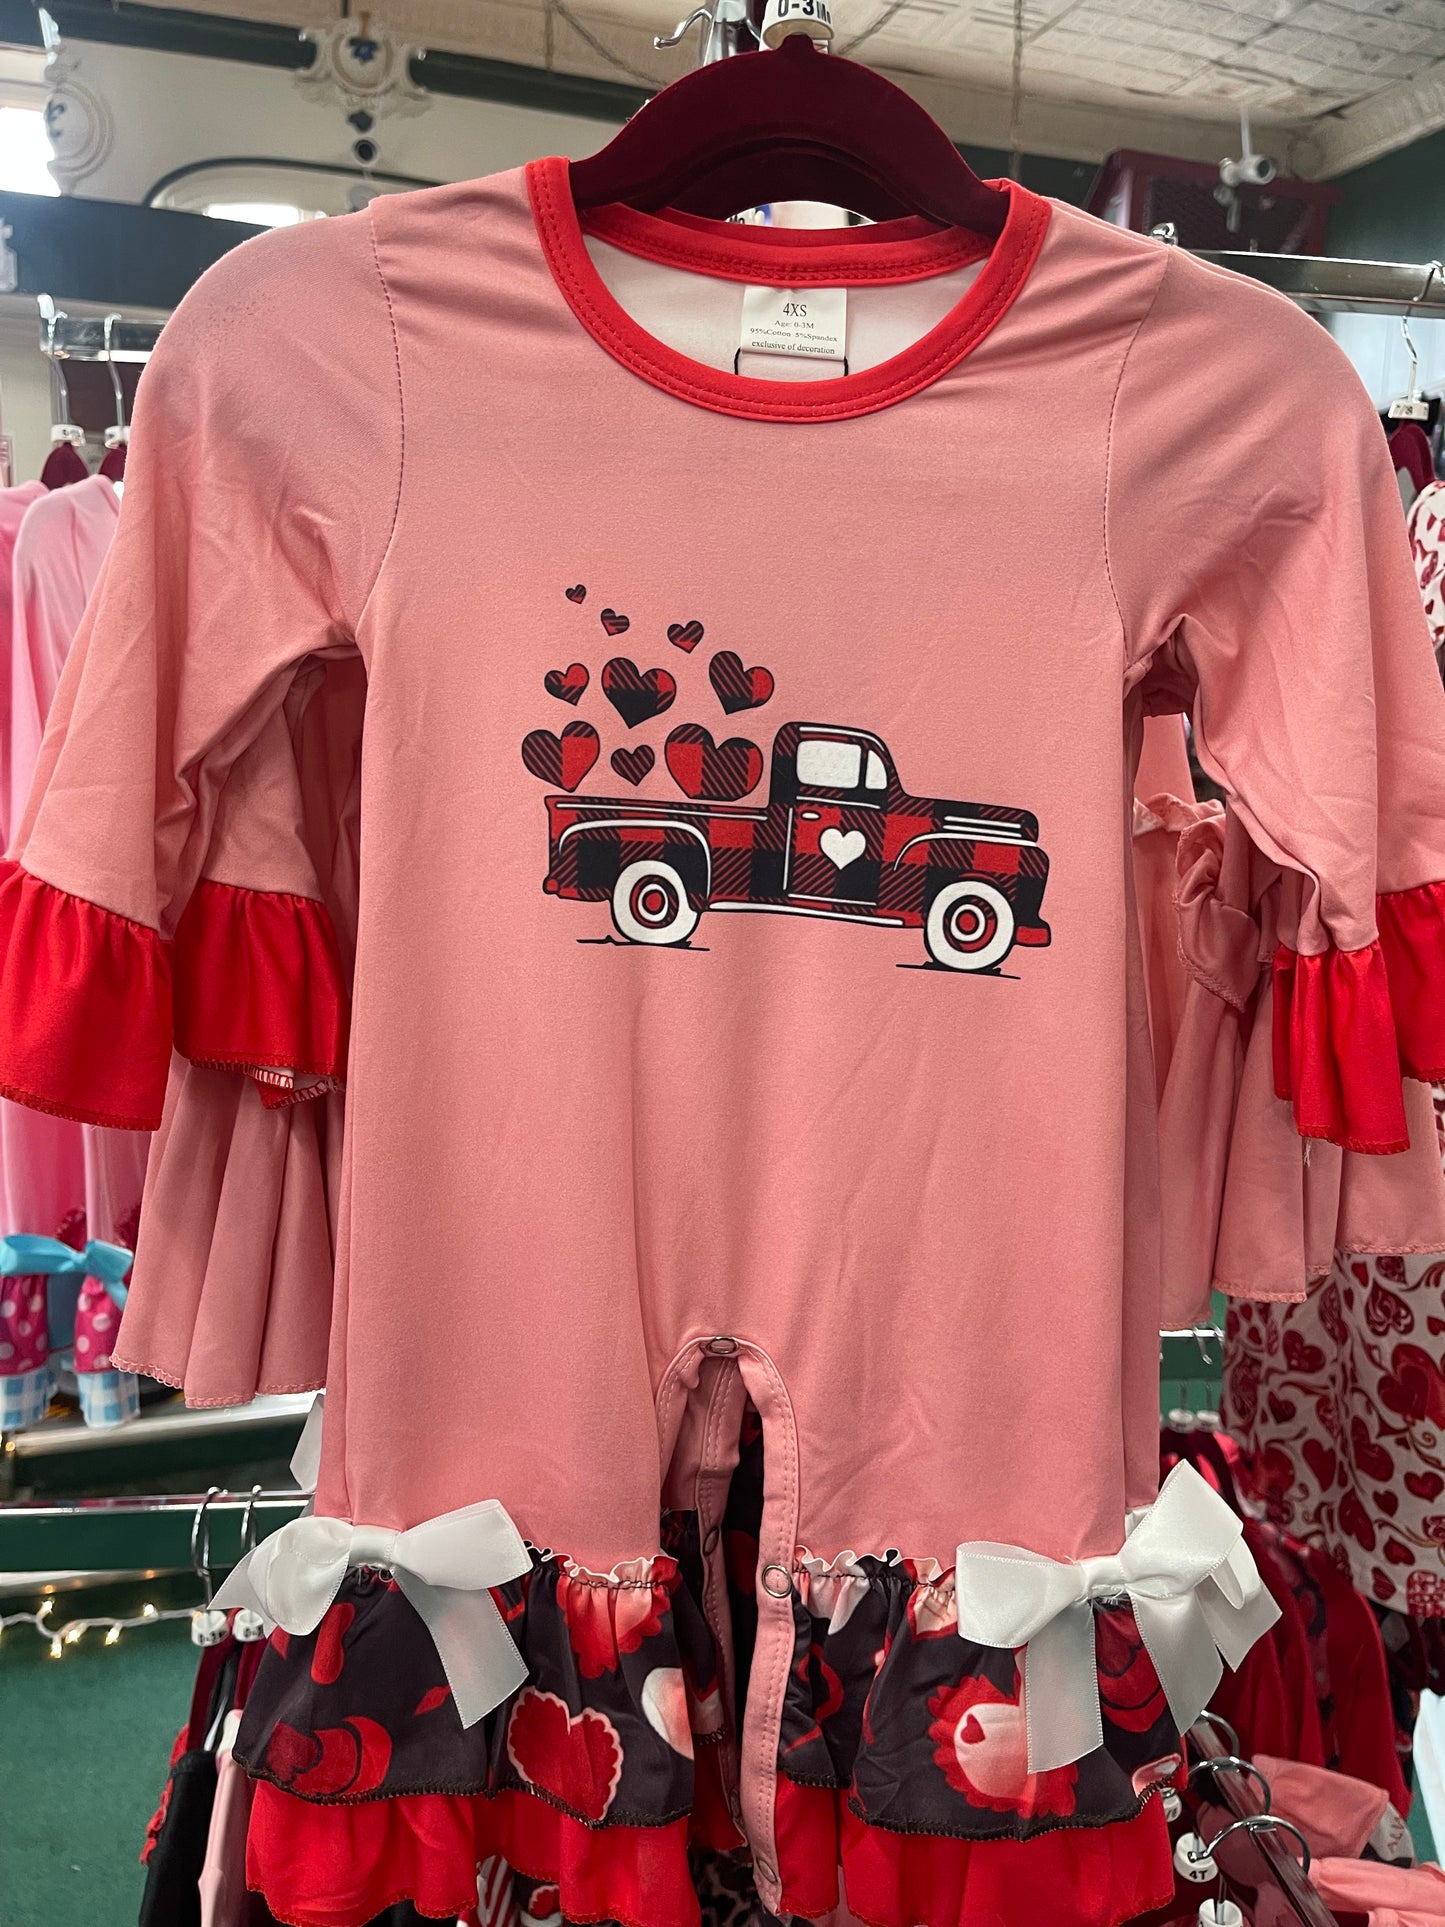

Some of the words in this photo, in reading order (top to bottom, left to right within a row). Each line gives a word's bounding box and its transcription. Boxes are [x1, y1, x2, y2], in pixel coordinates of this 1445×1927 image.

[782, 303, 807, 317] 4XS
[750, 328, 791, 337] 95%Cotton
[795, 332, 838, 343] 5%Spandex
[752, 340, 786, 350] exclusive
[787, 343, 795, 351] of
[797, 345, 835, 355] decoration
[1189, 1870, 1208, 1881] 4T
